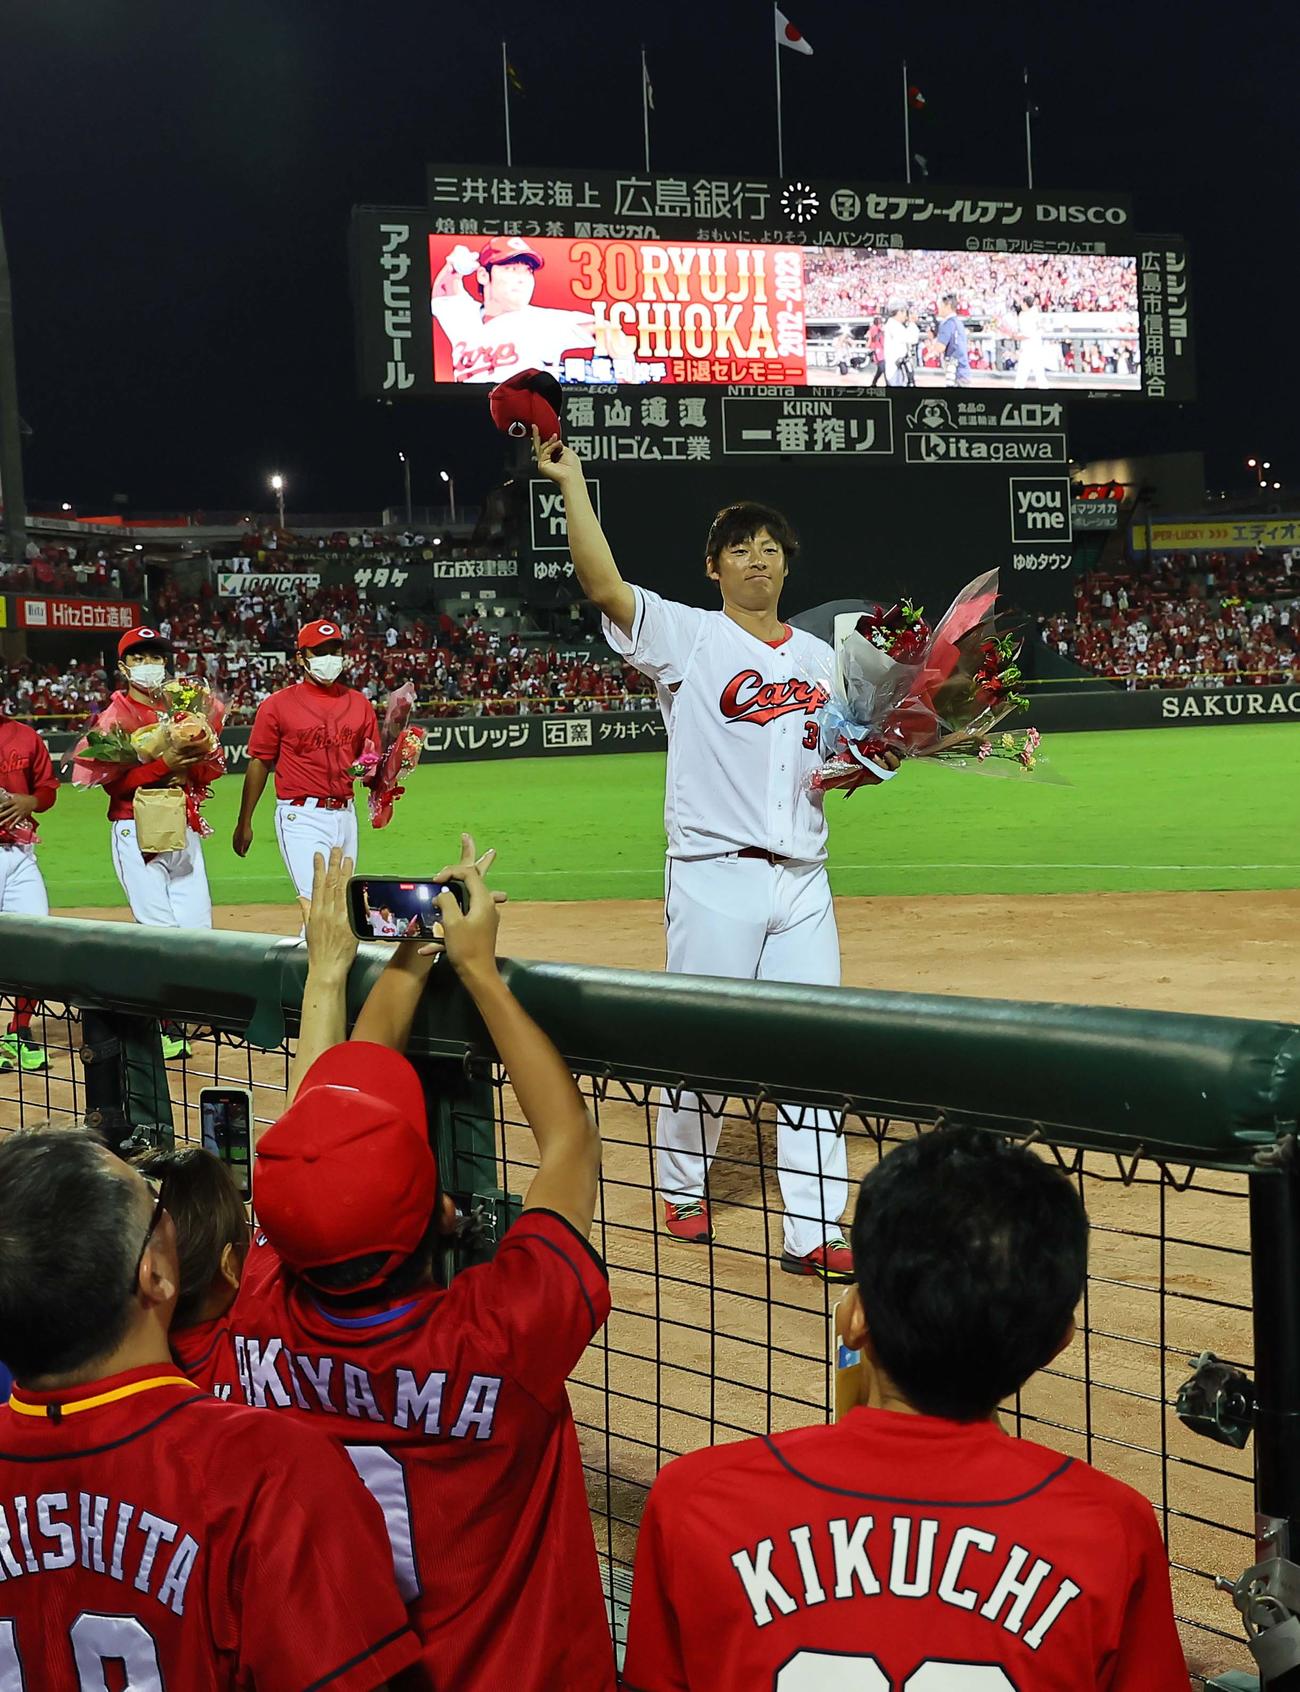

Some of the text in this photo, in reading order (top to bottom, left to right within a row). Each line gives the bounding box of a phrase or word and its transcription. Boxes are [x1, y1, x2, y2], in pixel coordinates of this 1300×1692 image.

[433, 177, 601, 208] 三井住友海上
[614, 177, 771, 221] 広島銀行
[1036, 204, 1127, 225] DISCO
[435, 217, 564, 237] 焙煎ごぼう茶
[813, 231, 904, 248] JAバンク広島
[569, 242, 769, 302] 30 RYUJI
[380, 224, 415, 390] アサヒビール
[591, 301, 779, 358] ICHIOKA
[1141, 251, 1166, 397] 広島市信用組合
[672, 360, 803, 382] 引退セレモニー
[567, 396, 707, 428] 福山通運
[783, 401, 832, 416] KIRIN
[1000, 403, 1063, 426] ムロオ
[742, 418, 875, 451] 一番搾り
[567, 435, 712, 461] 西川ゴム工業
[538, 494, 566, 518] yo
[1018, 489, 1061, 513] you
[550, 517, 568, 535] m
[1027, 510, 1065, 529] me
[1232, 523, 1300, 541] エディオ
[433, 560, 519, 579] 広成建設
[534, 561, 574, 579] ゆめタ
[1013, 553, 1072, 571] ゆめタウン
[353, 568, 409, 588] サタケ
[52, 603, 133, 628] Hitz日立造船
[423, 723, 530, 751] ビバレッジ
[546, 721, 668, 745] 石窯 タカキベー
[234, 1334, 502, 1441] AKIYAMA
[730, 1514, 1082, 1651] KIKUCHI
